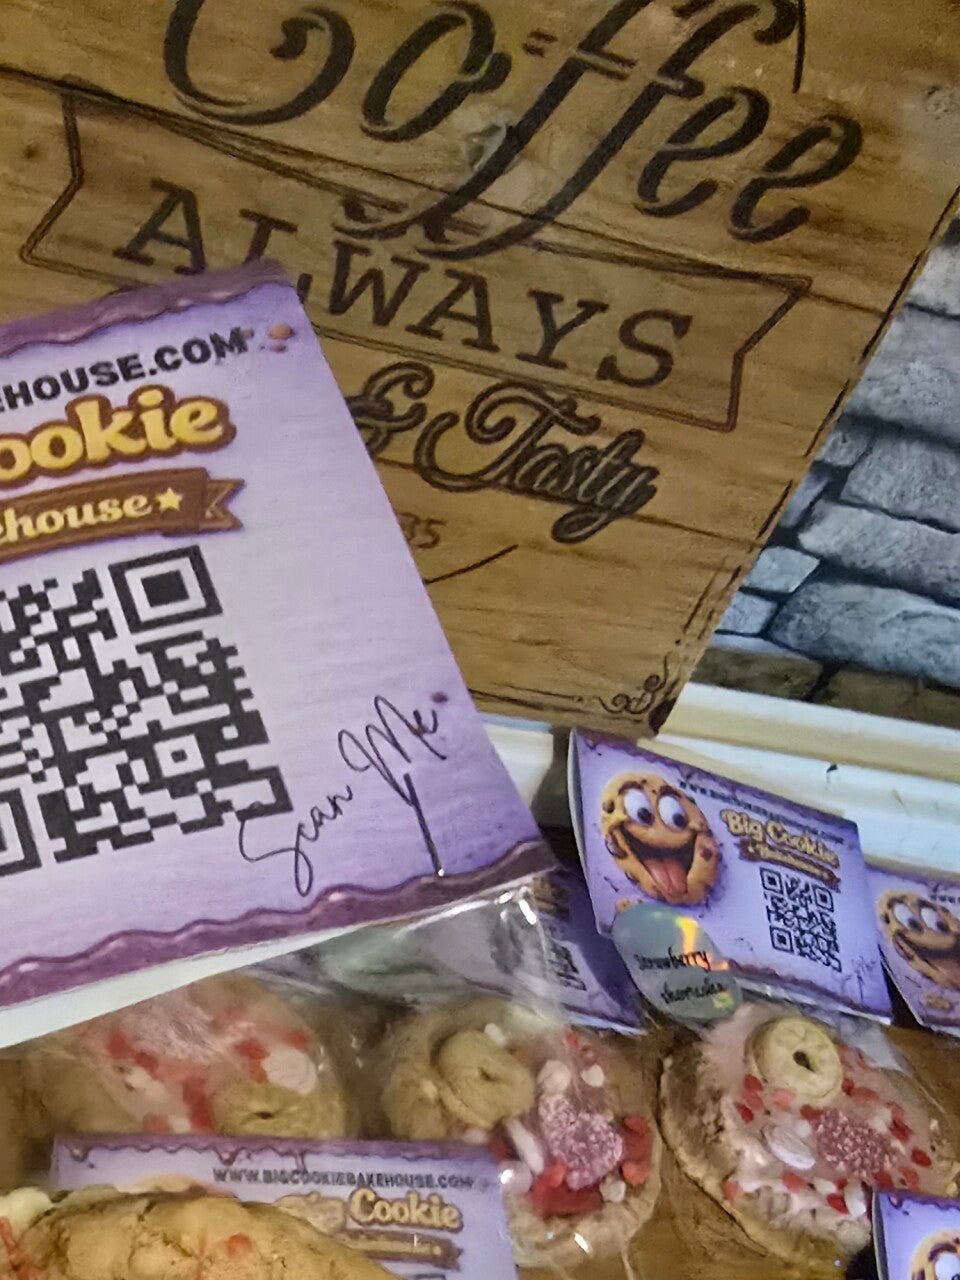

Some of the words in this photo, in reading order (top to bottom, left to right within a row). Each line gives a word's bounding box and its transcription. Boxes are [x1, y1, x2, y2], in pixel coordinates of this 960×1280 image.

[163, 0, 864, 260] Coffee
[414, 380, 659, 544] Tasty
[349, 1188, 464, 1233] Cookie
